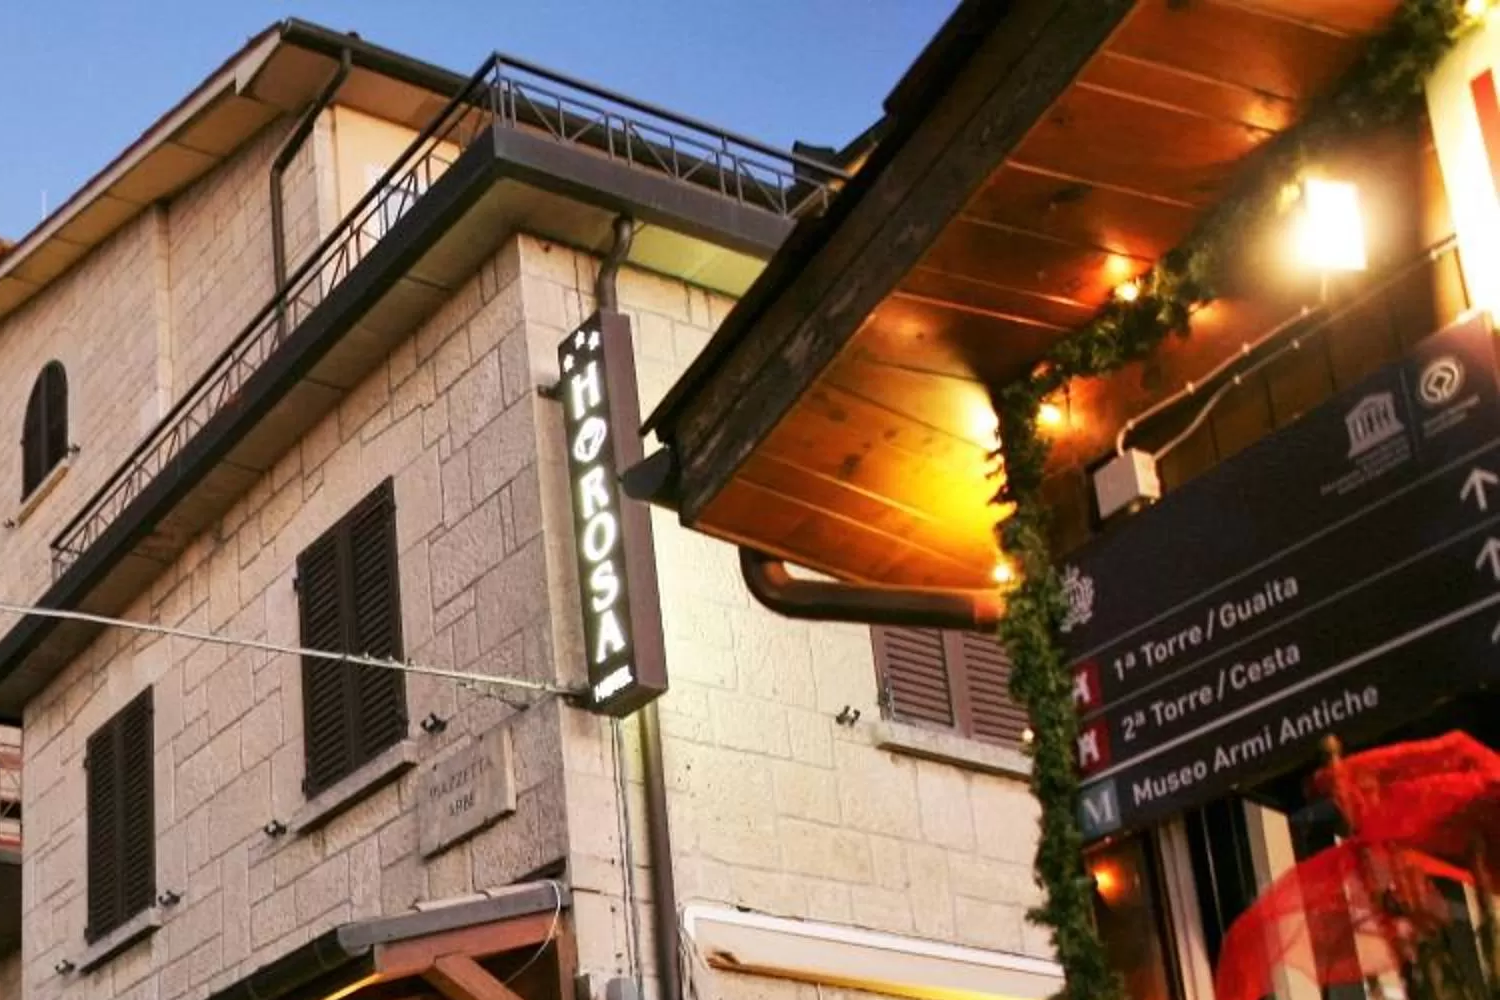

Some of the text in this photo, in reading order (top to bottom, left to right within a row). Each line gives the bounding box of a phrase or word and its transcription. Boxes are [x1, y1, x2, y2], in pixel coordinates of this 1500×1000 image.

[1140, 625, 1202, 667] Torre
[1219, 576, 1299, 629] Guaita
[1151, 685, 1213, 727] Torre
[1229, 644, 1300, 690] Cesta
[1132, 760, 1207, 806] Museo
[1213, 724, 1273, 773] Armi
[1279, 685, 1379, 745] Antiche
